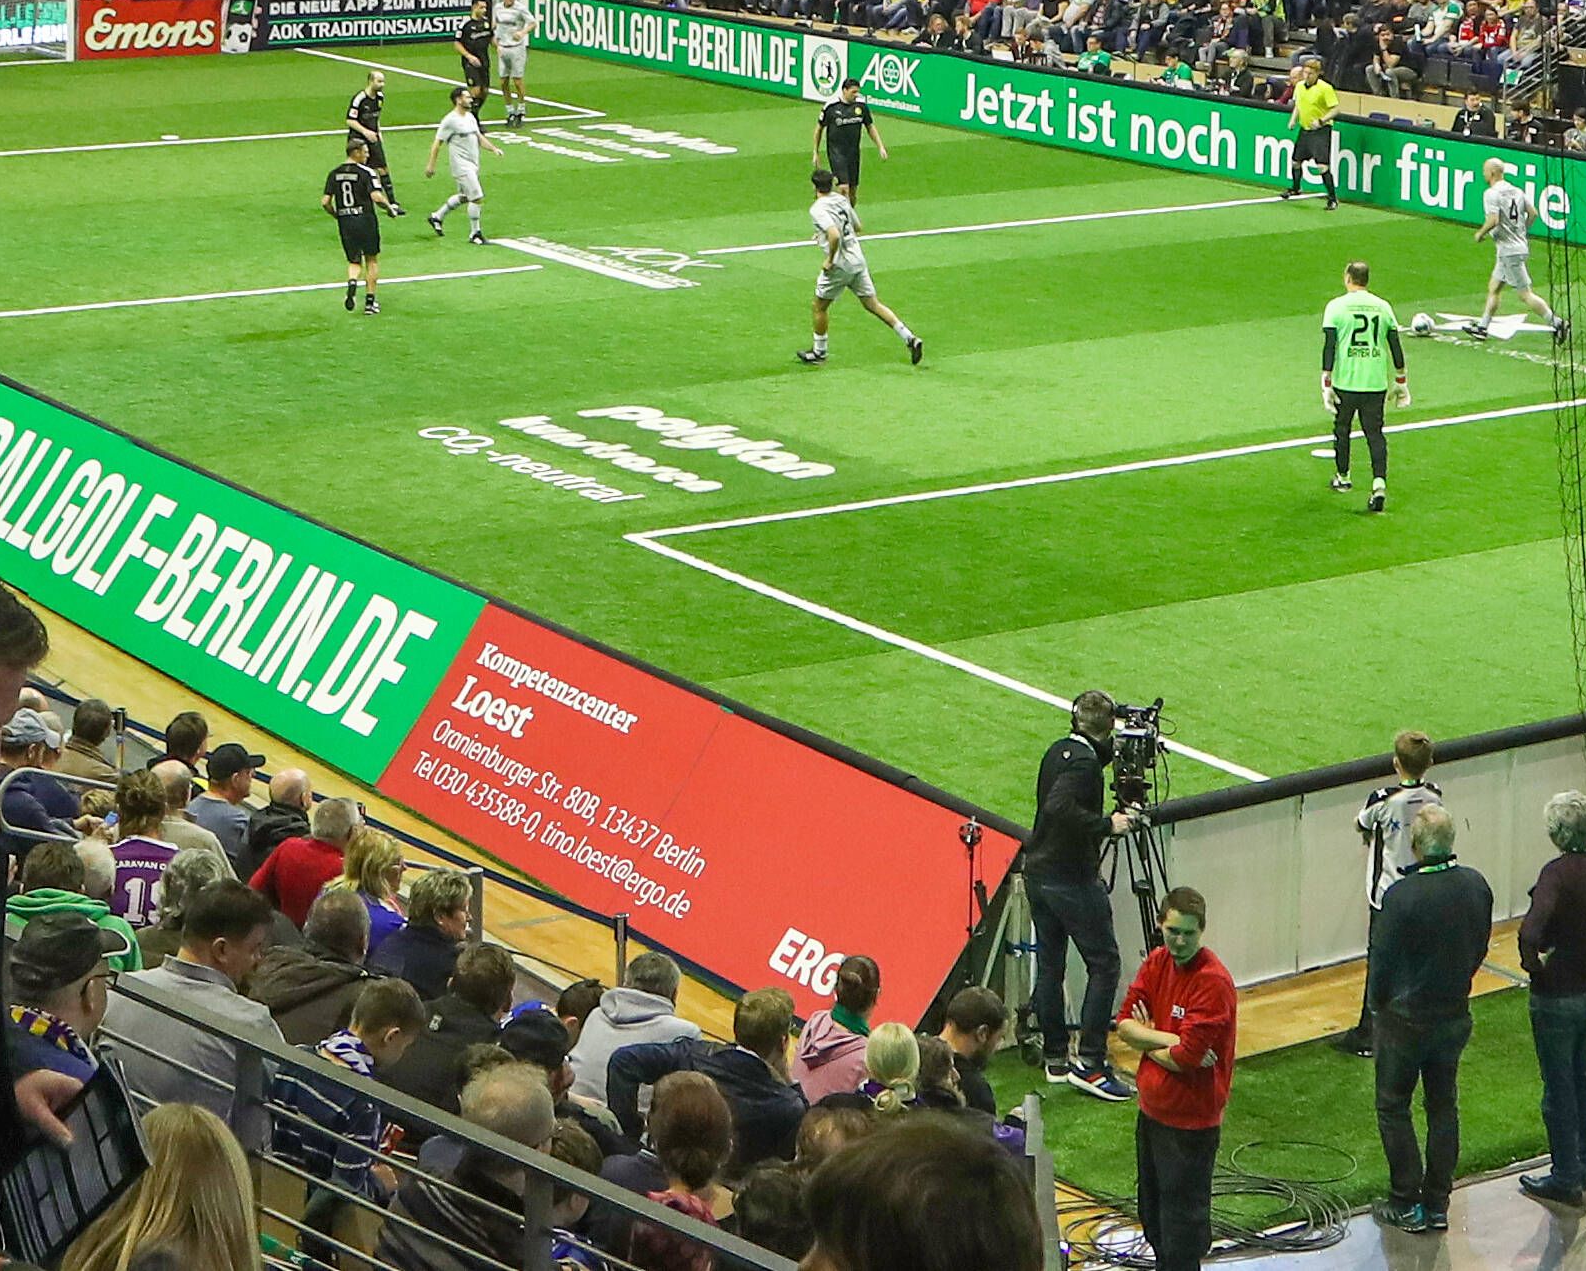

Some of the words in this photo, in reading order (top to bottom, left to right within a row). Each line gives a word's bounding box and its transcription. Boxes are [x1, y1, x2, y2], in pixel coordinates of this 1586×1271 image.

[84, 7, 216, 52] Emons
[268, 1, 298, 16] DIE
[299, 0, 341, 14] NEUE
[269, 21, 306, 41] AOK
[860, 53, 921, 98] AOK
[960, 73, 1055, 136] Jetzt
[1067, 87, 1116, 148] ist
[1129, 110, 1239, 171] noch
[1396, 140, 1475, 212] für
[341, 180, 355, 207] 8
[1509, 198, 1519, 224] 4
[1352, 313, 1379, 346] 21
[1346, 346, 1371, 359] BAYER
[451, 674, 535, 739] Loest
[476, 642, 639, 734] Kompetenzcenter
[432, 719, 540, 788] Oranienburger
[533, 771, 563, 804] Str.
[562, 785, 601, 827] 80B,
[599, 804, 661, 850] 13437
[652, 833, 707, 879] Berlin
[412, 751, 435, 781] Tel
[433, 763, 469, 796] 030
[463, 778, 543, 841] 435588-0,
[539, 821, 692, 919] tino.loest@ergo.de
[768, 926, 845, 996] ERG
